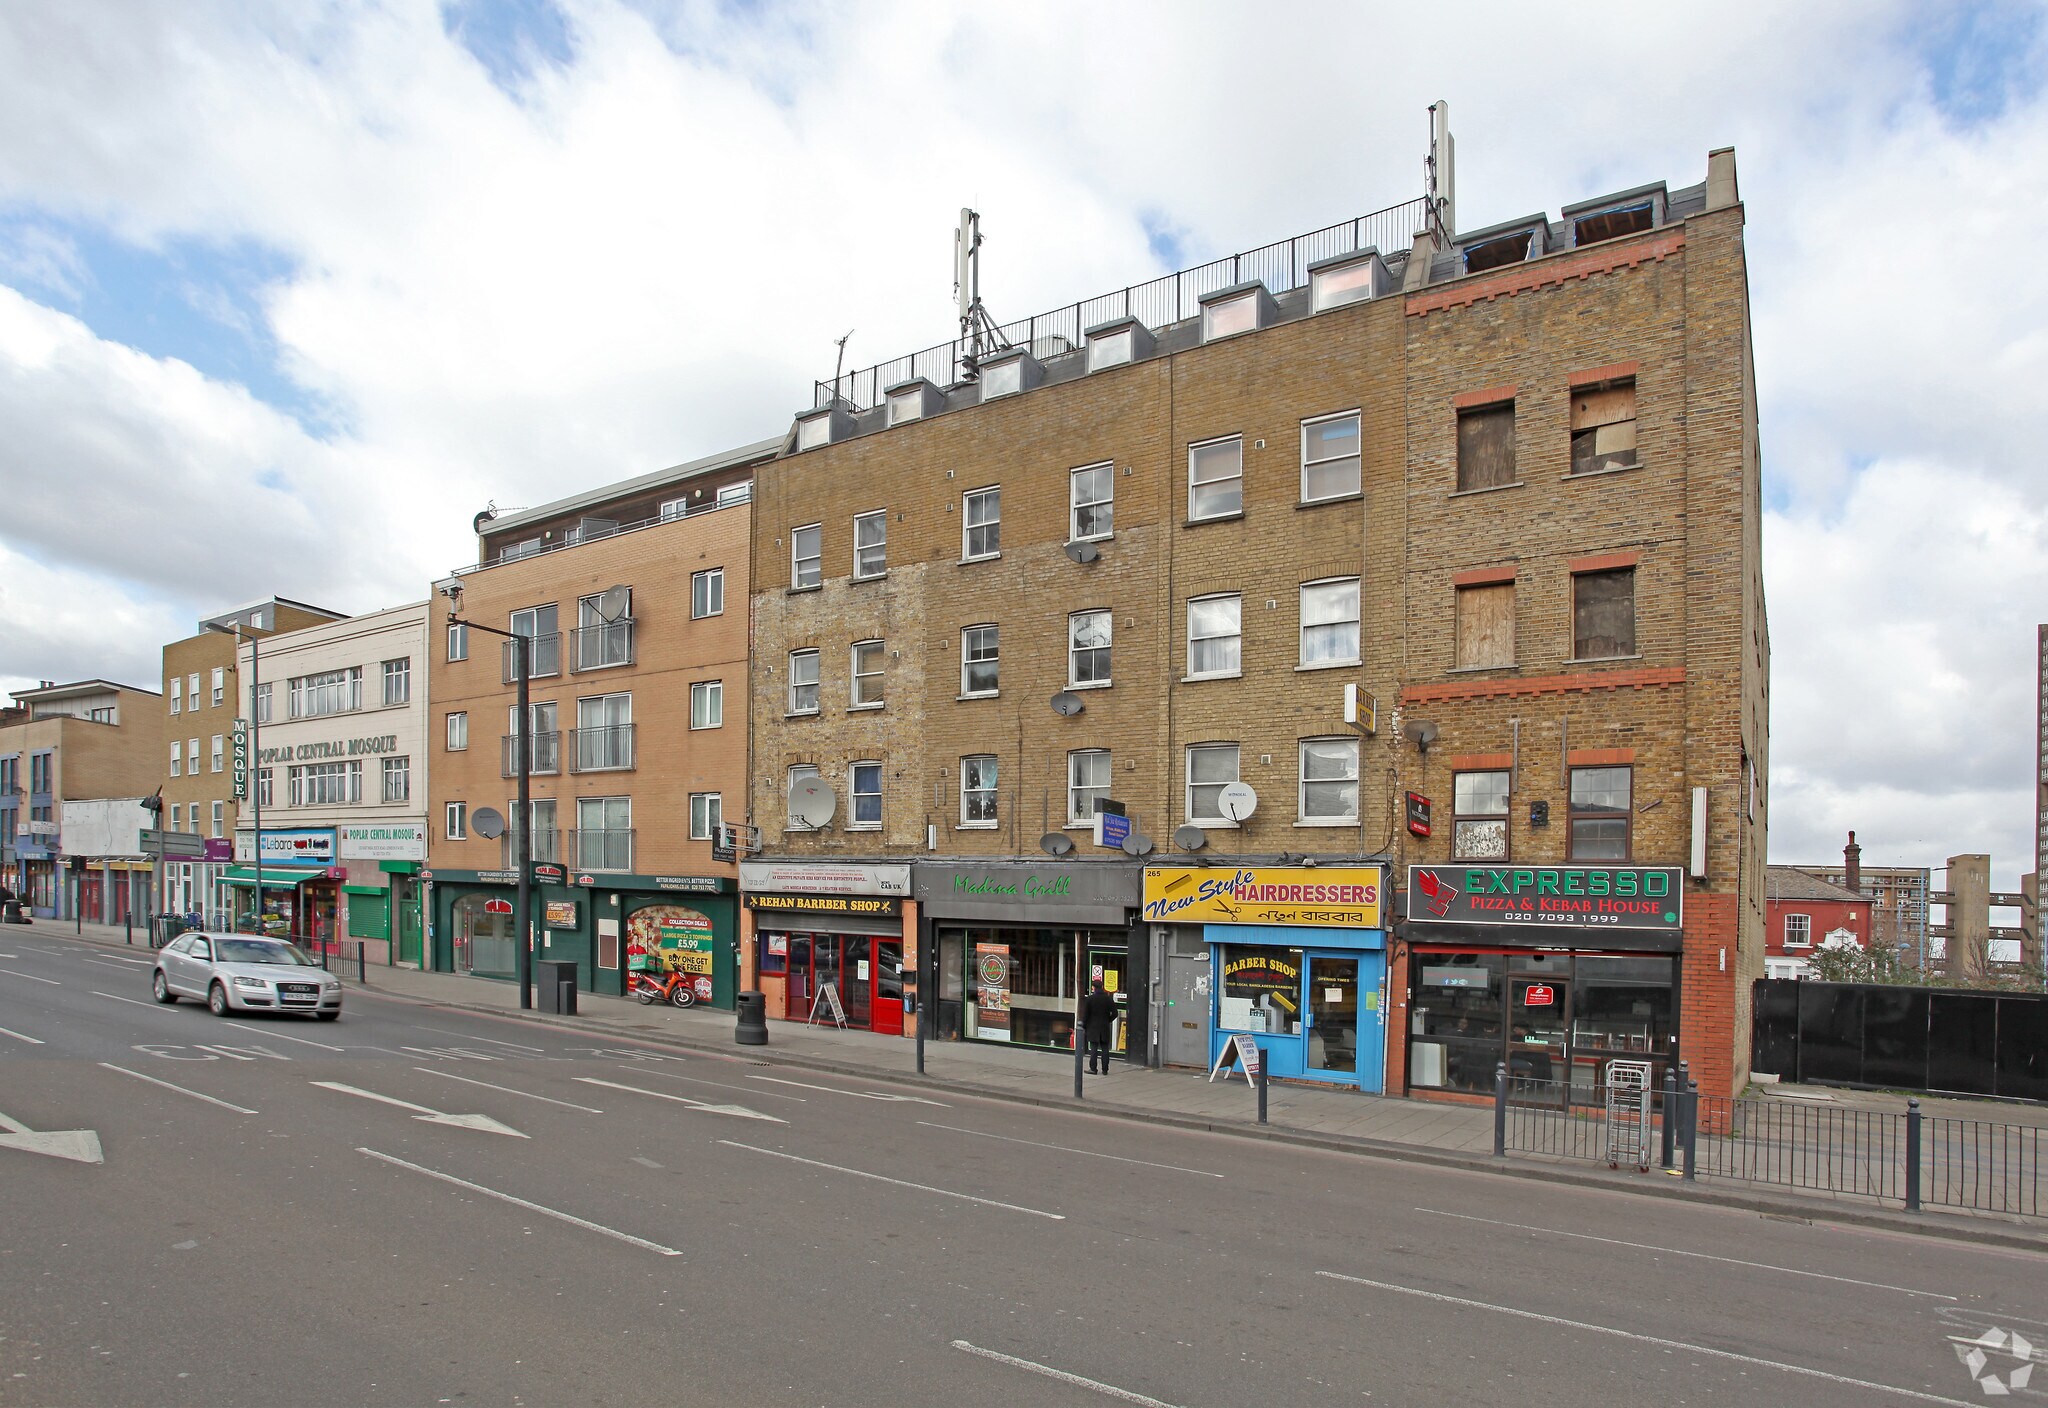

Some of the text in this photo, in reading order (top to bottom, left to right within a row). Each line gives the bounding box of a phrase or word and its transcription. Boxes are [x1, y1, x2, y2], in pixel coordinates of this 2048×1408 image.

[1356, 687, 1374, 712] BARBER
[1359, 707, 1371, 728] SHOP
[234, 721, 246, 795] MOSQUE
[258, 734, 397, 764] POPLAR CENTRAL MOSQUE
[267, 837, 292, 850] Lebara
[350, 829, 414, 840] POPLAR CENTRAL MOSQUE
[954, 874, 1017, 894] Madina
[1024, 875, 1071, 898] Grill
[1234, 884, 1377, 903] HAIRDRESSERS
[1465, 870, 1669, 897] EXPRESSO
[1145, 870, 1254, 918] New Style
[759, 897, 880, 912] REHAN BARRBER SHOP
[1471, 896, 1660, 914] PIZZA & KEBAB HOUSE
[1538, 914, 1574, 922] 7093
[1583, 914, 1618, 923] 1999
[678, 940, 698, 949] £5.99
[1225, 958, 1267, 976] BARBER
[1270, 959, 1296, 978] SHOP
